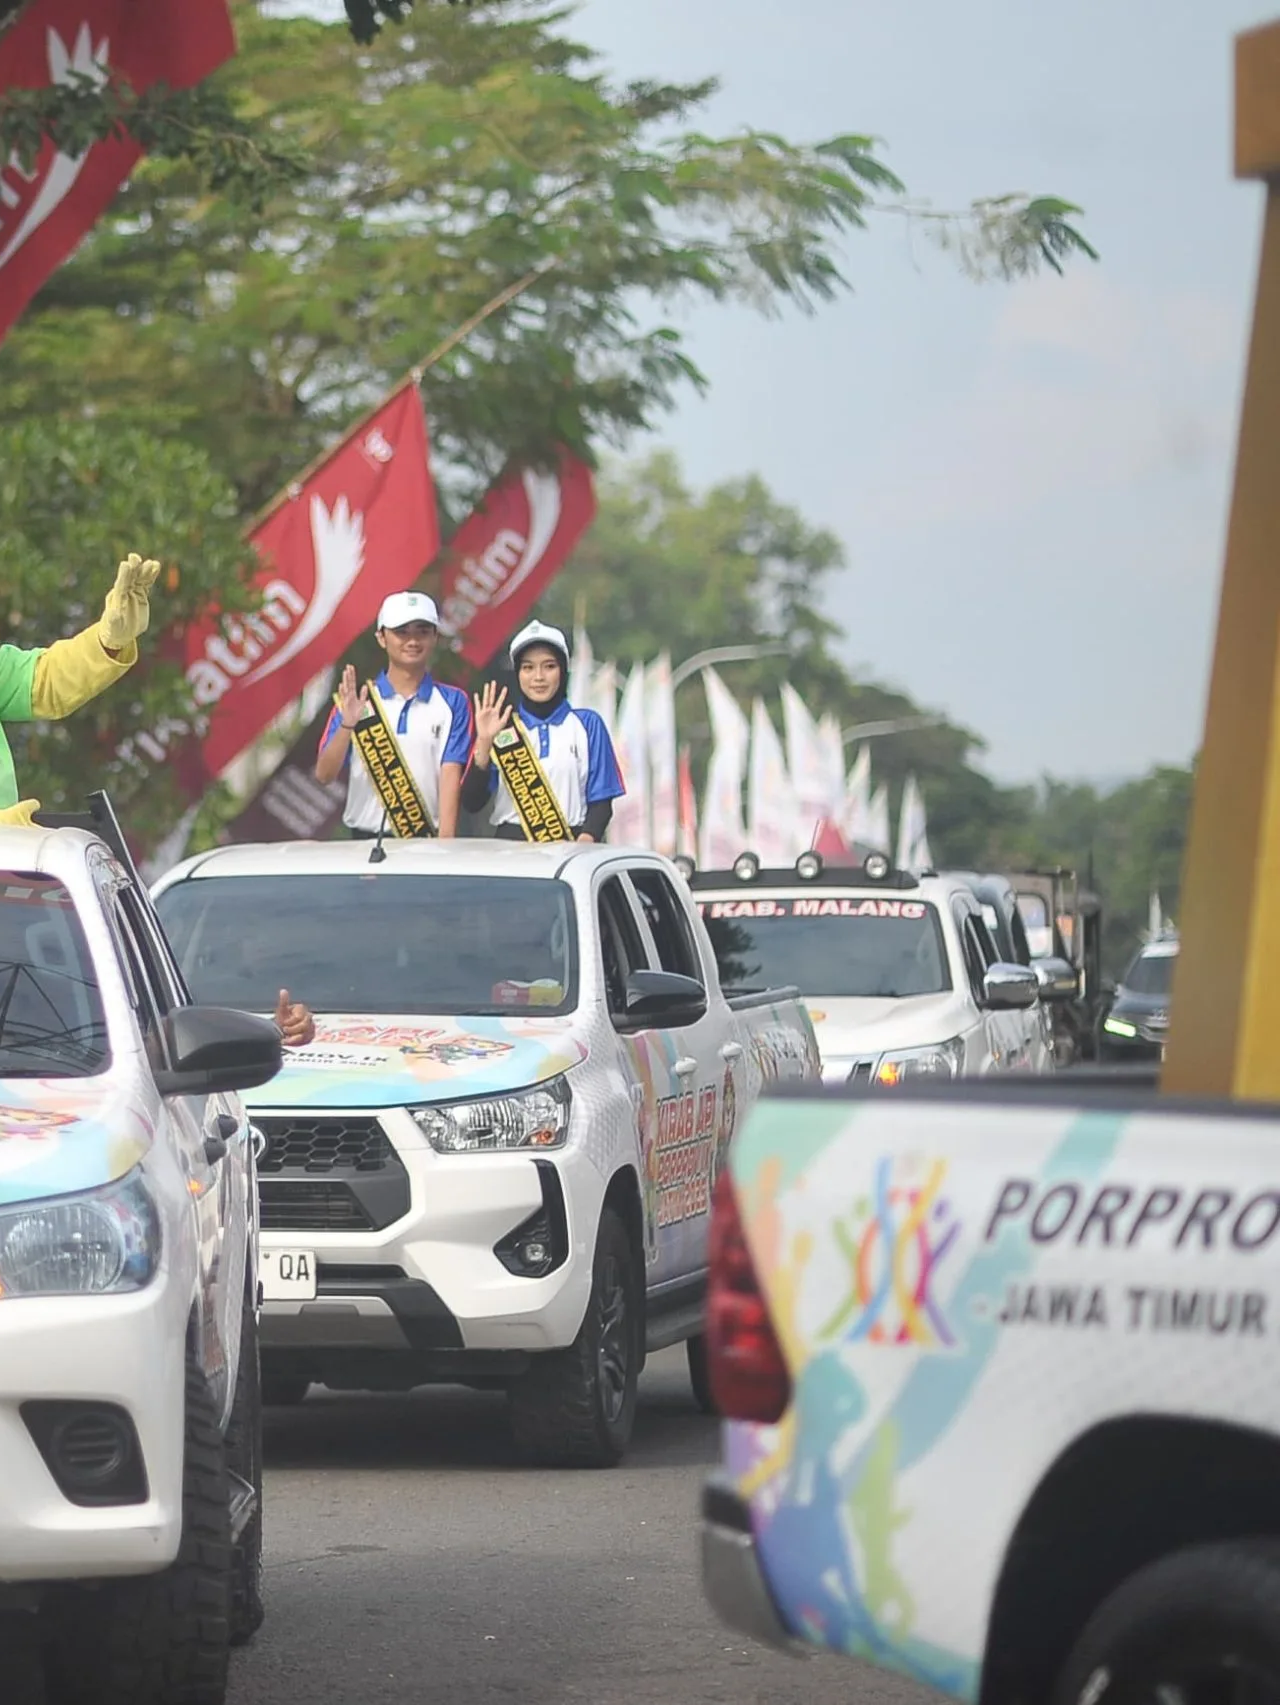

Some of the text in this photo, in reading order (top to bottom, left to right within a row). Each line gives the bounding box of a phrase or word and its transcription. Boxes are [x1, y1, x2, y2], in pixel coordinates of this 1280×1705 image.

[357, 729, 399, 813] KABUPATEN
[369, 721, 425, 834] DUTA PEMUDA
[499, 751, 540, 828] KABUPATEN
[513, 747, 565, 843] DUTA PEMUD
[711, 901, 785, 919] KAB.
[793, 899, 927, 919] MALANG
[278, 1253, 311, 1283] QA
[999, 1285, 1267, 1336] JAWA TIMUR
